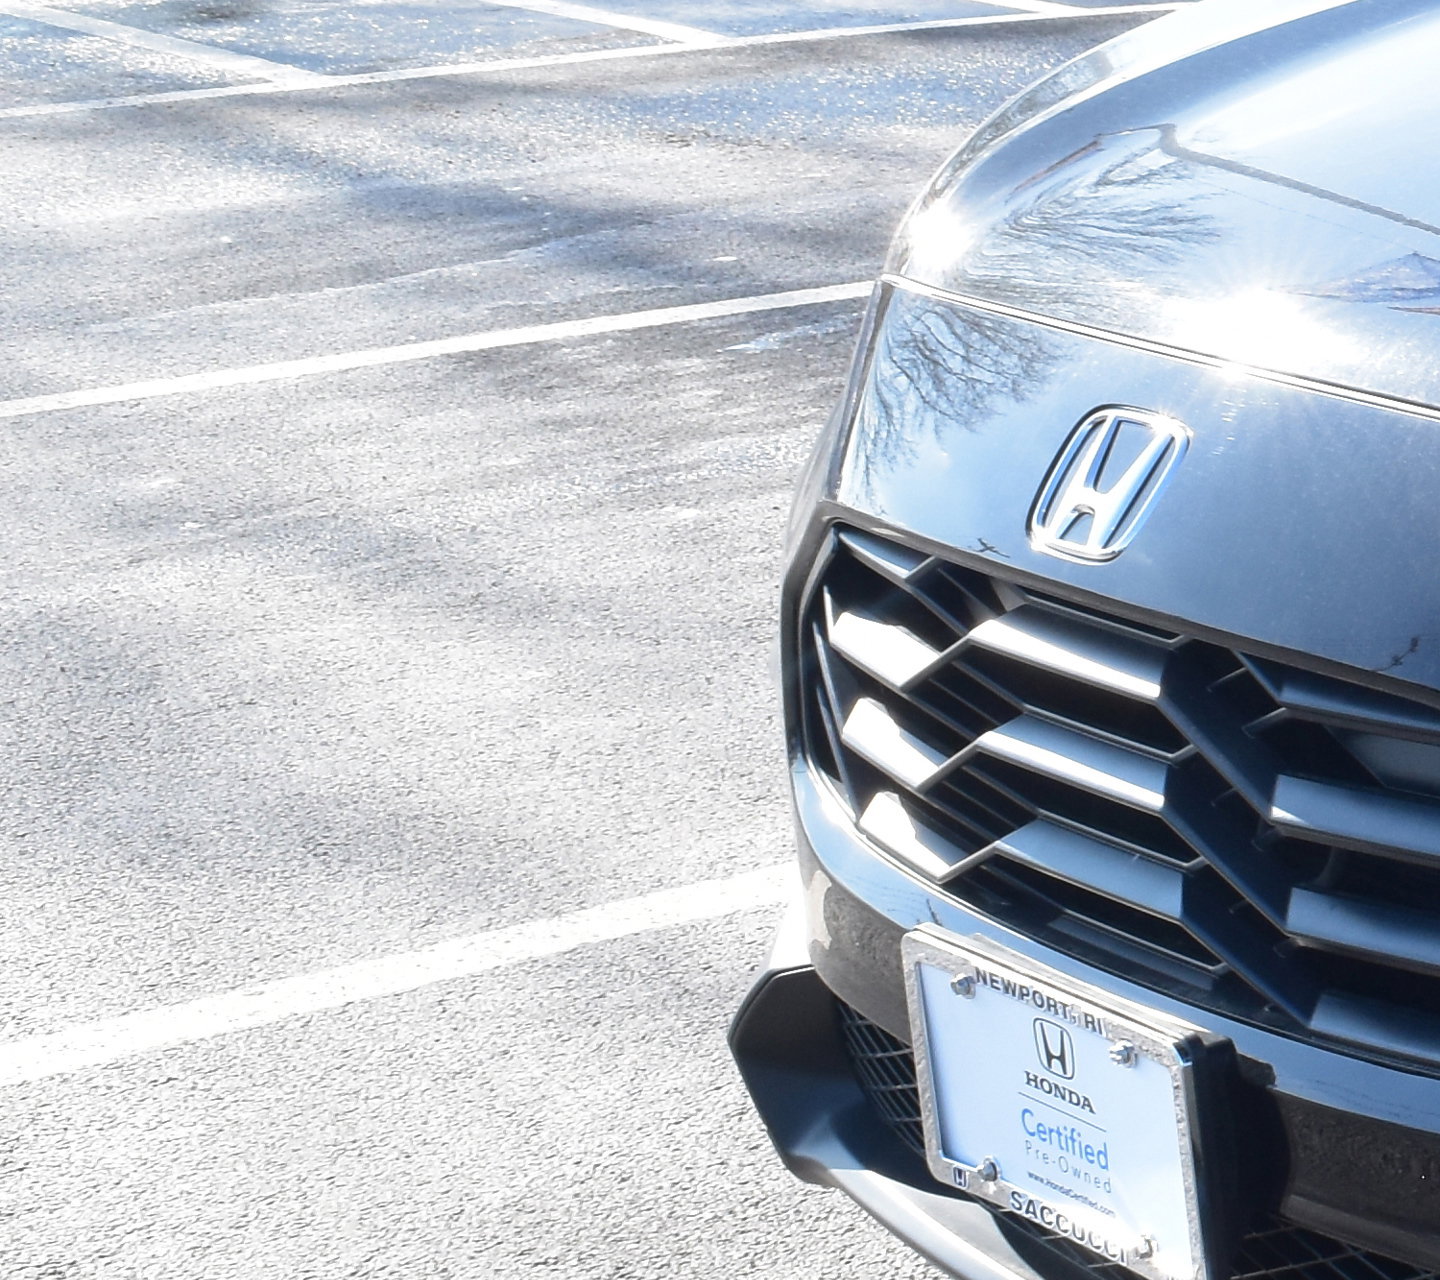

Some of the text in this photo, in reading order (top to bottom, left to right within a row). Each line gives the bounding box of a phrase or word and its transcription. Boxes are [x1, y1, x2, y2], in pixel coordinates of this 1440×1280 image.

[1024, 1070, 1096, 1114] HONDA
[1021, 1108, 1109, 1171] Certified
[1025, 1139, 1111, 1193] Pre-Owned
[1010, 1190, 1125, 1264] SACCUCCI
